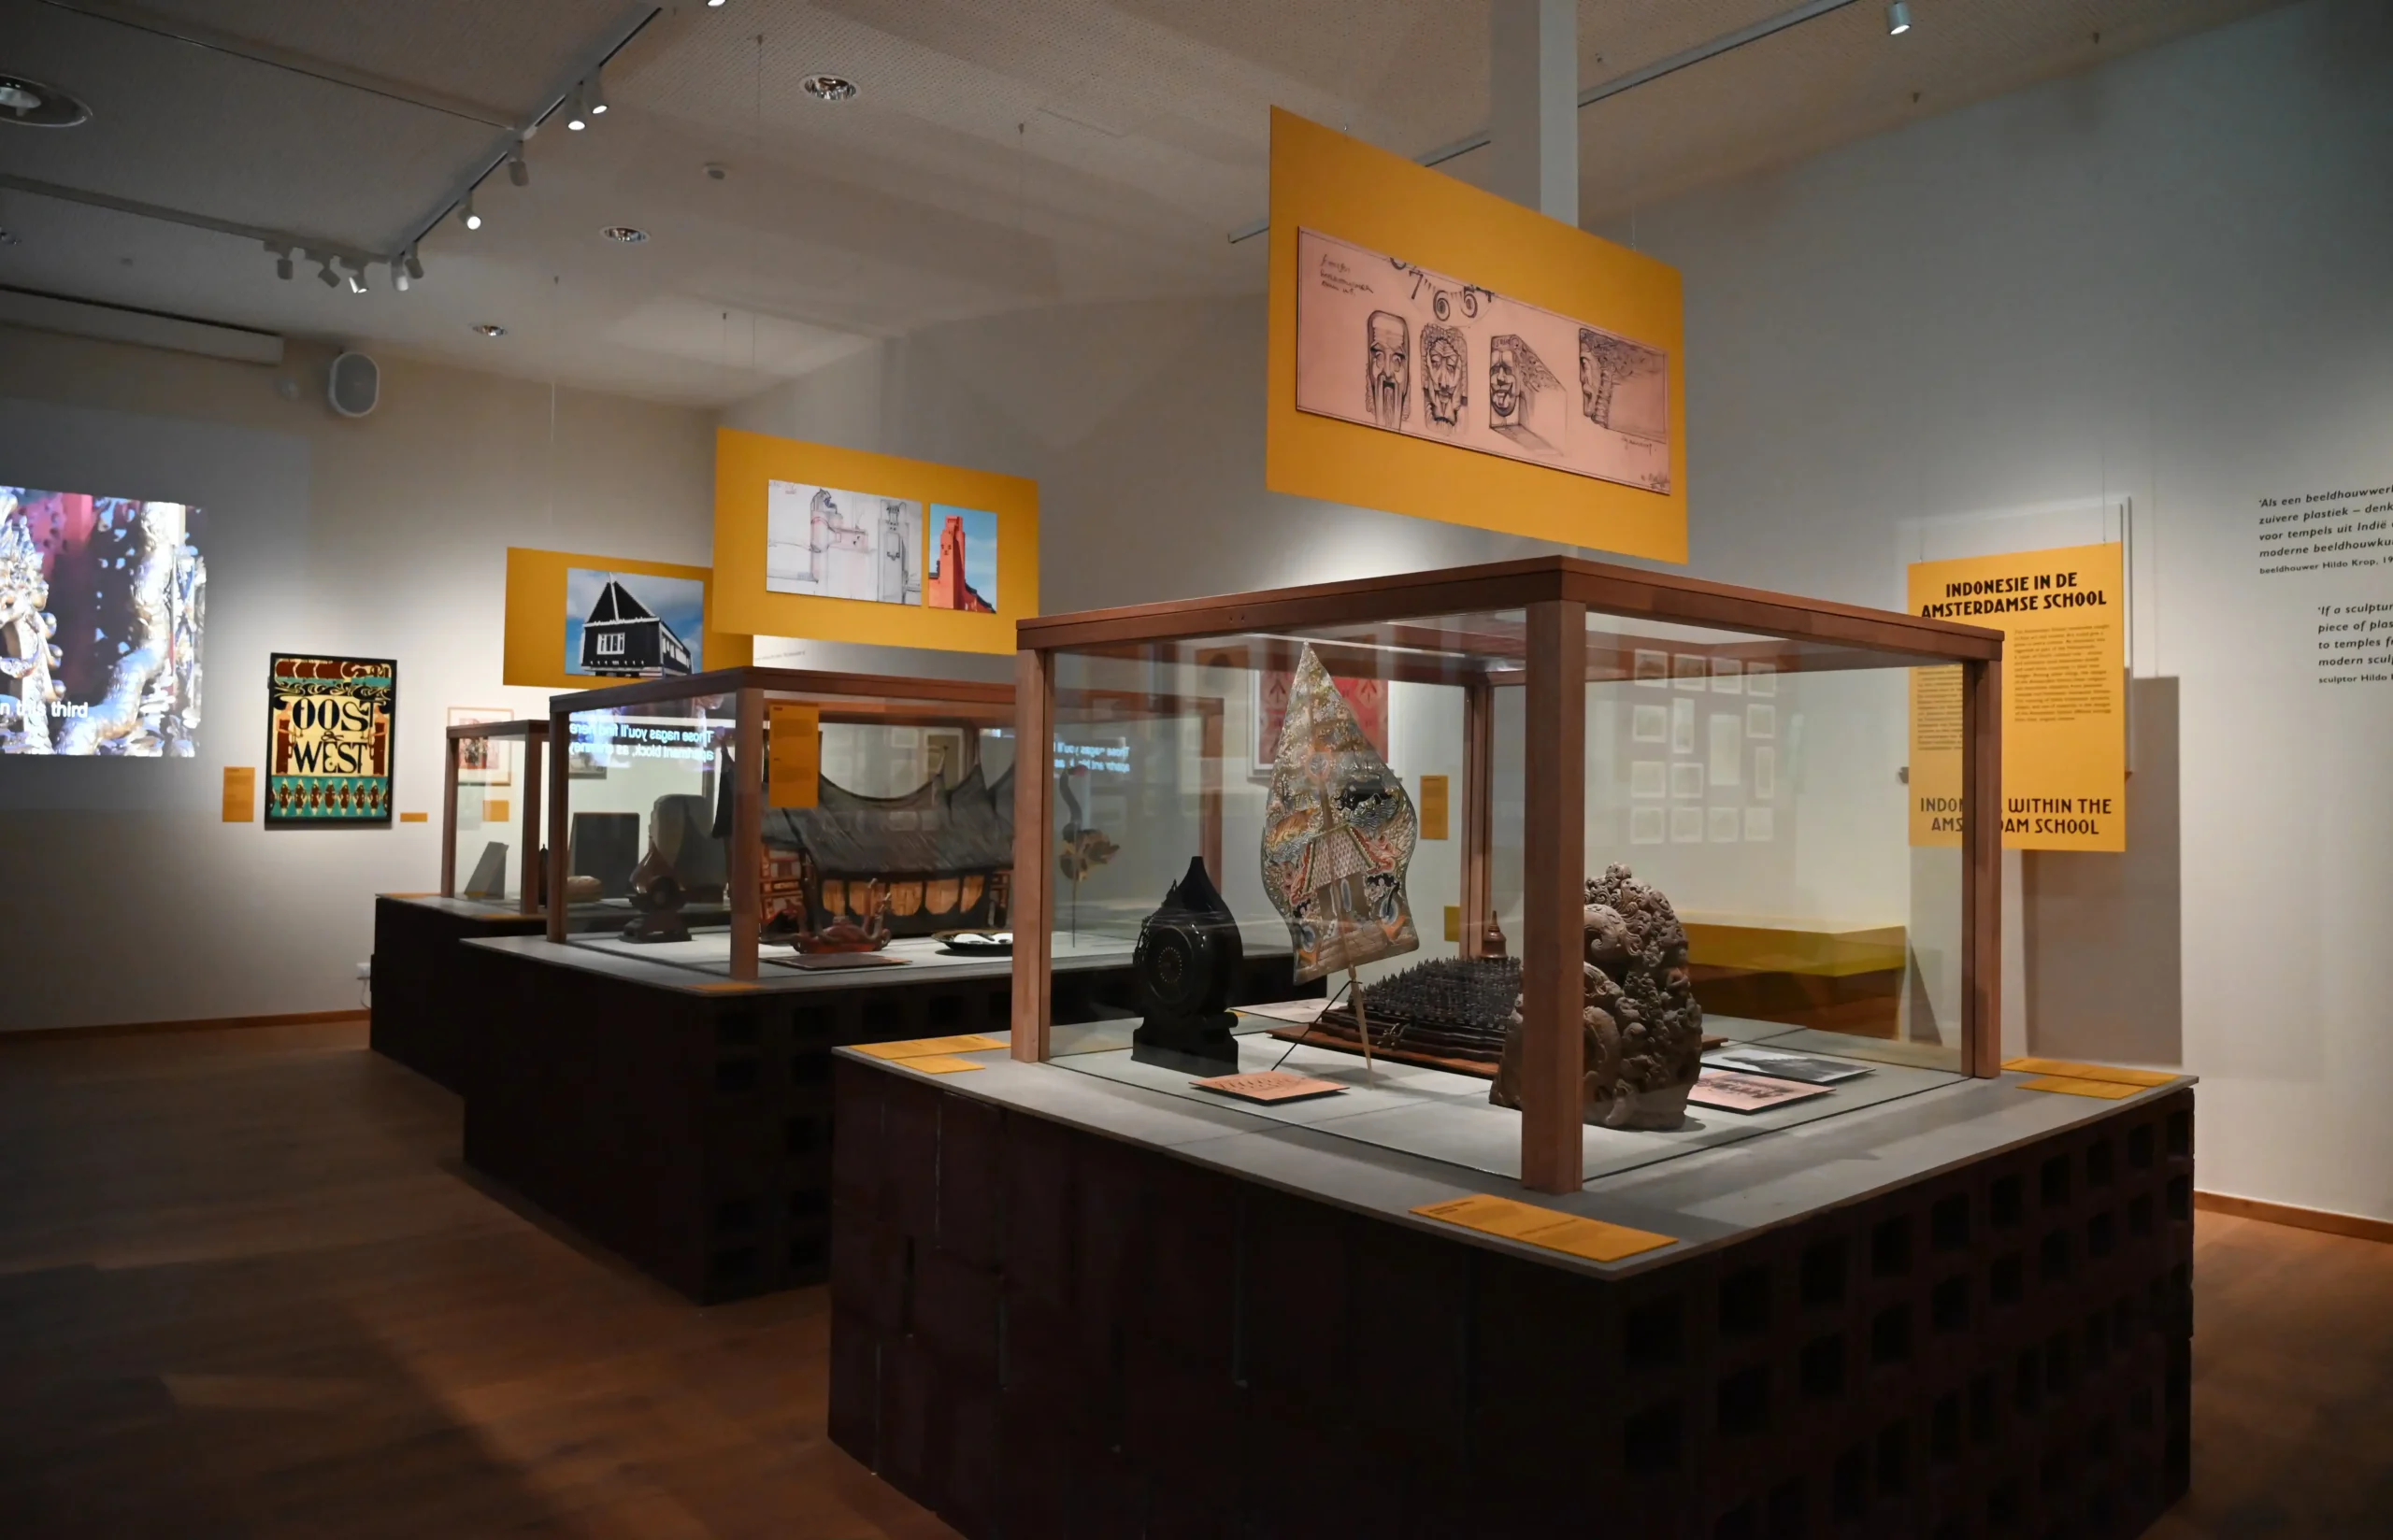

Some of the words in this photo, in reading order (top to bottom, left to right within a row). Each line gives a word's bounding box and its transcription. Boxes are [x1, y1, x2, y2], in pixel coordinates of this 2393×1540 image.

[2282, 497, 2301, 506] een
[2259, 514, 2299, 524] zuivere
[2303, 506, 2348, 522] plastiek
[2259, 533, 2283, 541] voor
[2288, 526, 2332, 538] tempels
[2337, 524, 2352, 534] uit
[2357, 520, 2386, 531] Indië
[2259, 548, 2309, 558] moderne
[2314, 538, 2393, 553] beeldhouwku
[2259, 563, 2319, 574] beeldhouwer
[2323, 561, 2348, 569] Hildo
[1946, 577, 2029, 598] INDONESIE
[2034, 575, 2050, 591] IN
[2056, 572, 2078, 588] DE
[1921, 596, 2039, 618] AMSTERDAMSE
[2043, 590, 2107, 608] SCHOOL
[2318, 623, 2349, 635] piece
[2353, 620, 2366, 632] of
[2335, 637, 2381, 649] temples
[2318, 656, 2363, 666] modern
[2318, 676, 2357, 684] sculptor
[51, 702, 89, 718] third
[293, 697, 374, 732] OOST
[294, 741, 368, 774] WEST
[2008, 798, 2071, 814] WITHIN
[2077, 798, 2112, 815] THE
[2035, 819, 2099, 834] SCHOOL
